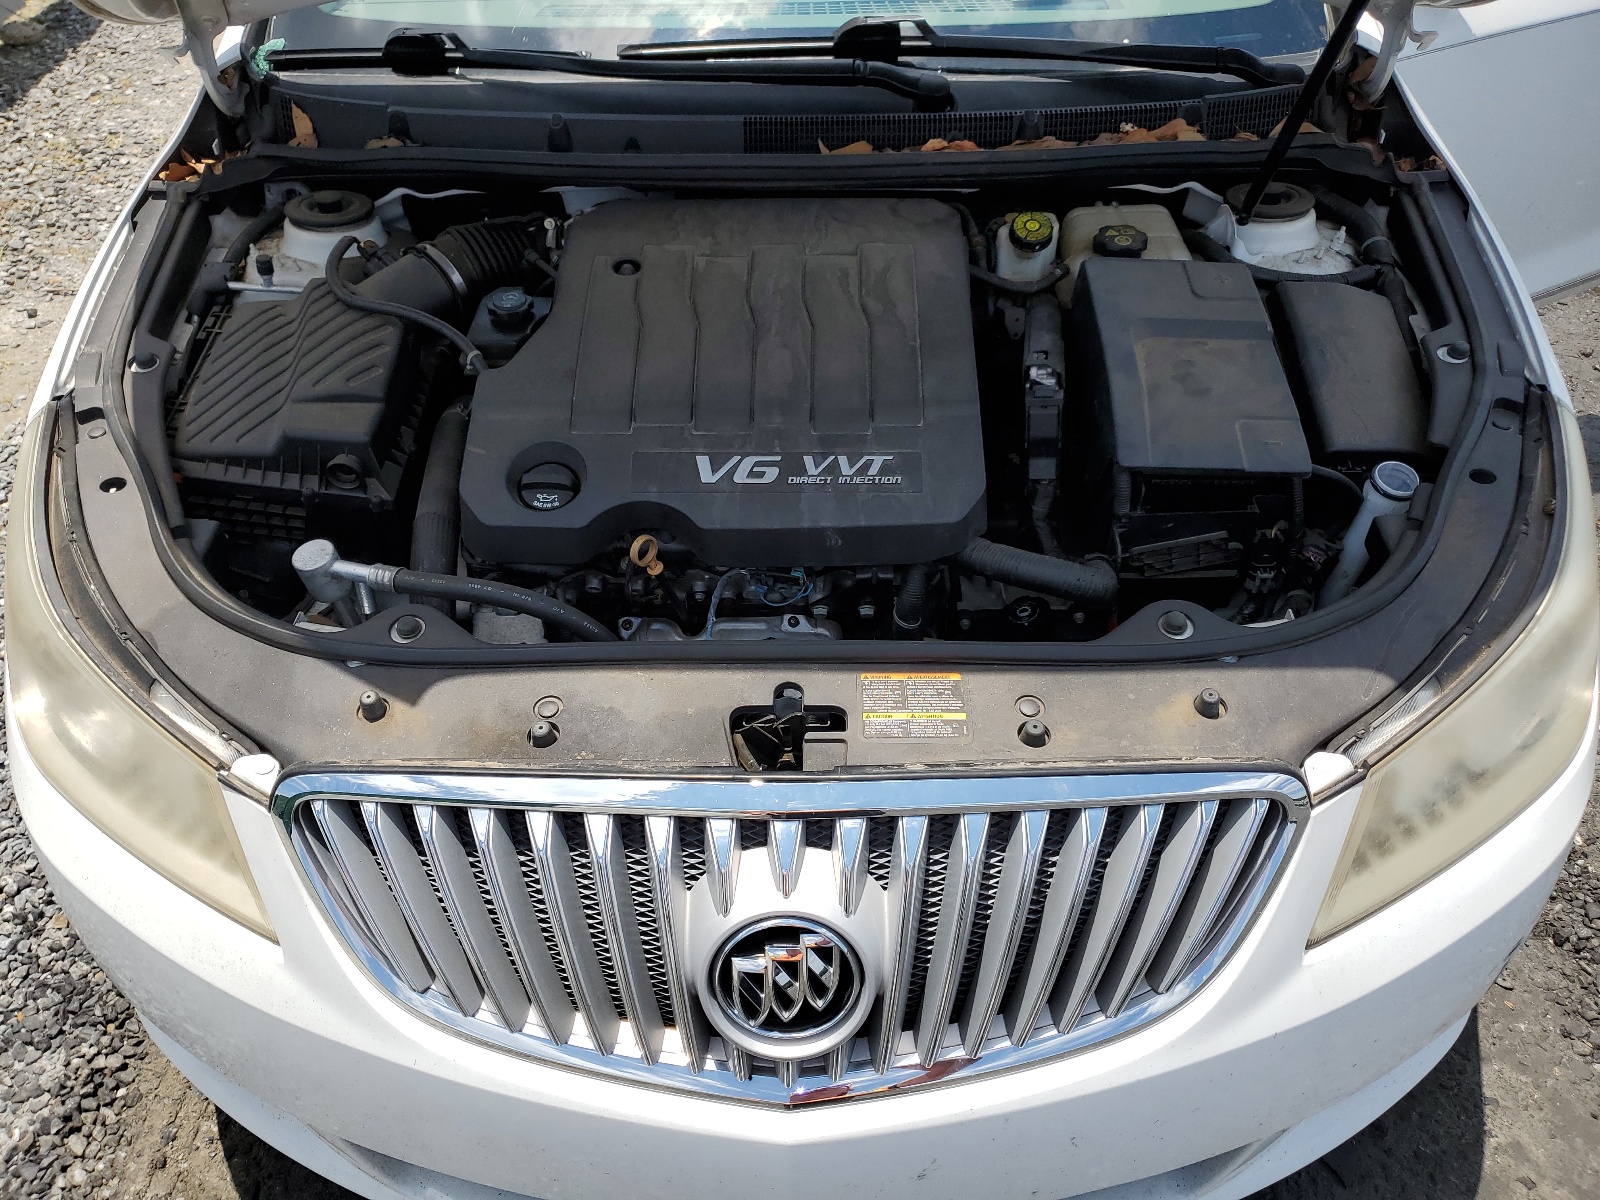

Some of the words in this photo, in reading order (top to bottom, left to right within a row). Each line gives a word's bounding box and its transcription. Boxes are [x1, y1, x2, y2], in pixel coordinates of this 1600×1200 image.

[695, 455, 782, 484] V6
[803, 455, 894, 476] VVT
[787, 476, 833, 484] DIRECT
[838, 476, 902, 484] INJECTION
[532, 500, 543, 508] SAE
